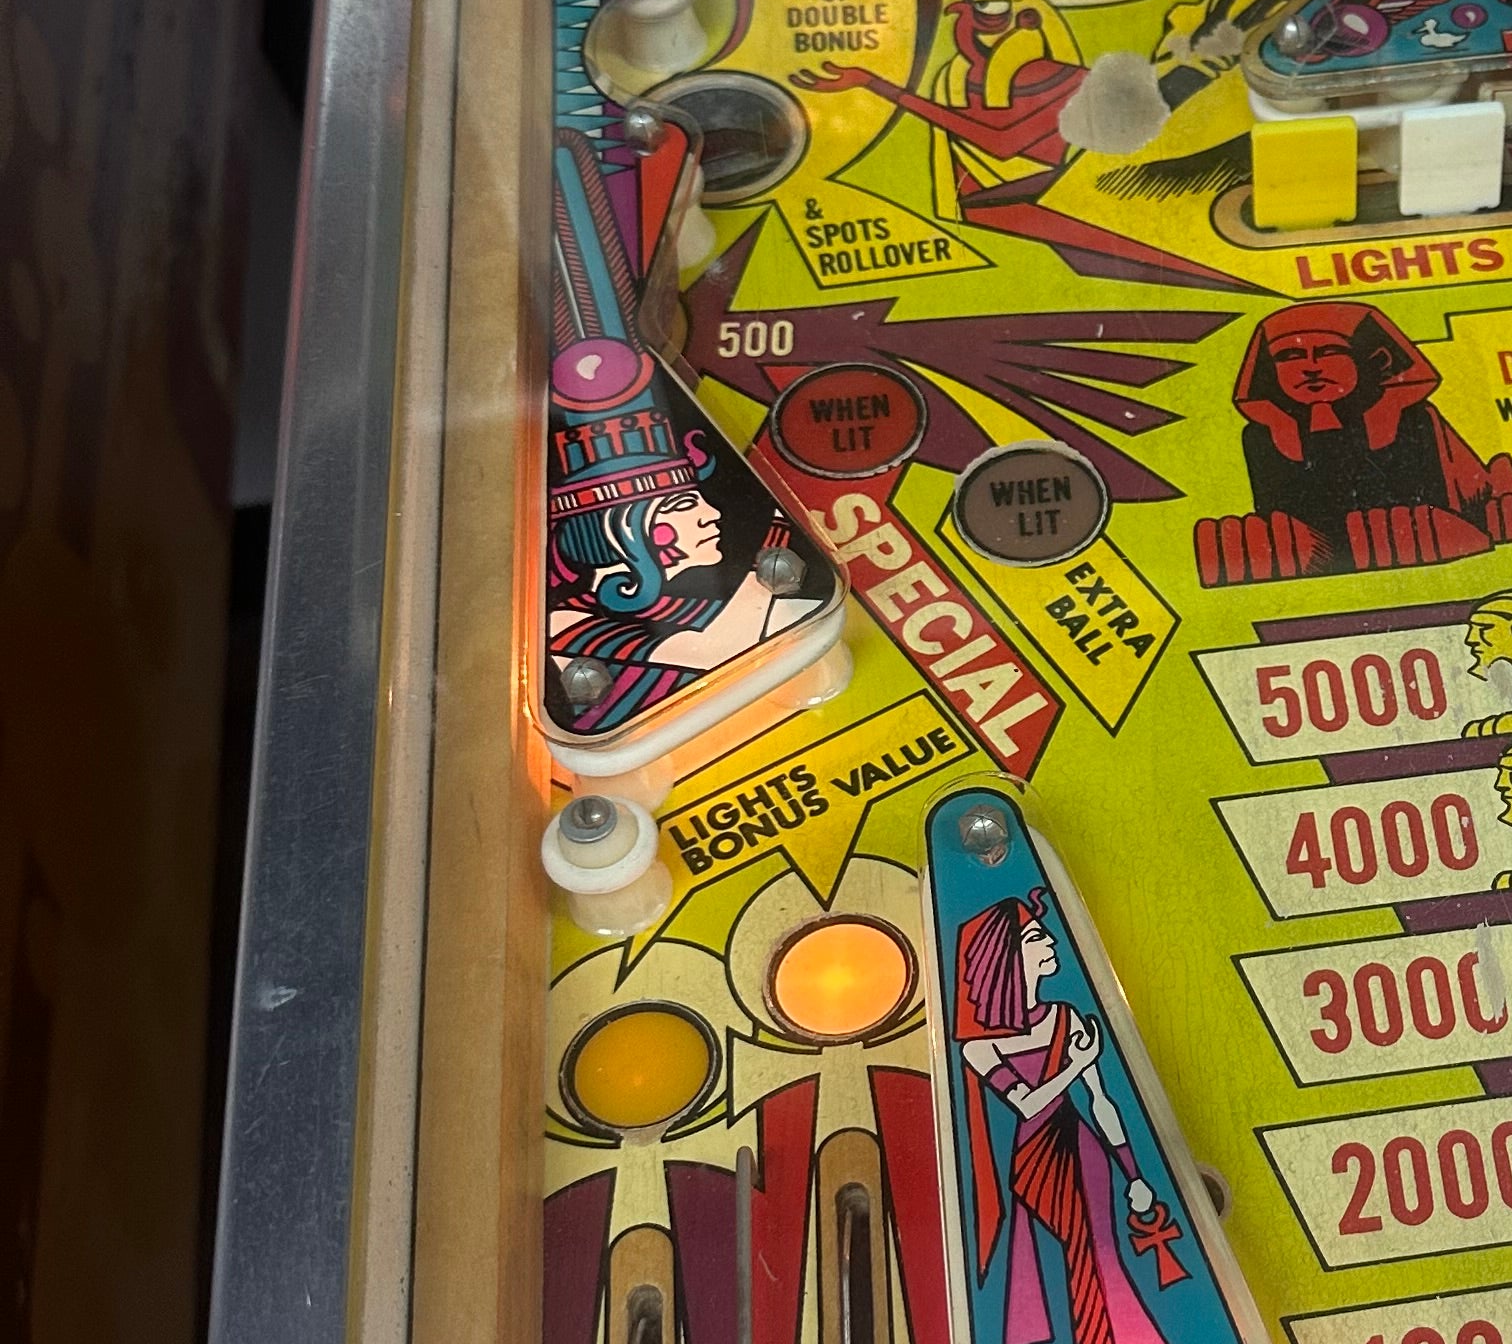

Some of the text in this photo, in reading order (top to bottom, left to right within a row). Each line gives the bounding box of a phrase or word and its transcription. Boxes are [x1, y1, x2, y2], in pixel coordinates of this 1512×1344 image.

[786, 3, 889, 29] DOUBLE
[794, 29, 880, 53] BONUS
[804, 198, 824, 220] &
[806, 218, 890, 249] SPOTS
[818, 238, 952, 276] ROLLOVER
[1296, 238, 1505, 290] LIGHTS
[717, 320, 794, 358] 500
[809, 394, 890, 424] WHEN
[831, 426, 876, 453] LIT
[989, 476, 1072, 507] WHEN
[1018, 510, 1061, 537] LIT
[808, 493, 1049, 757] SPECIAL
[1064, 561, 1157, 659] EXTRA
[1045, 595, 1115, 666] BALL
[1255, 648, 1448, 738] 5000
[668, 764, 817, 851] LIGHTS
[681, 727, 957, 877] BONUS VALUE
[1285, 793, 1480, 889] 4000
